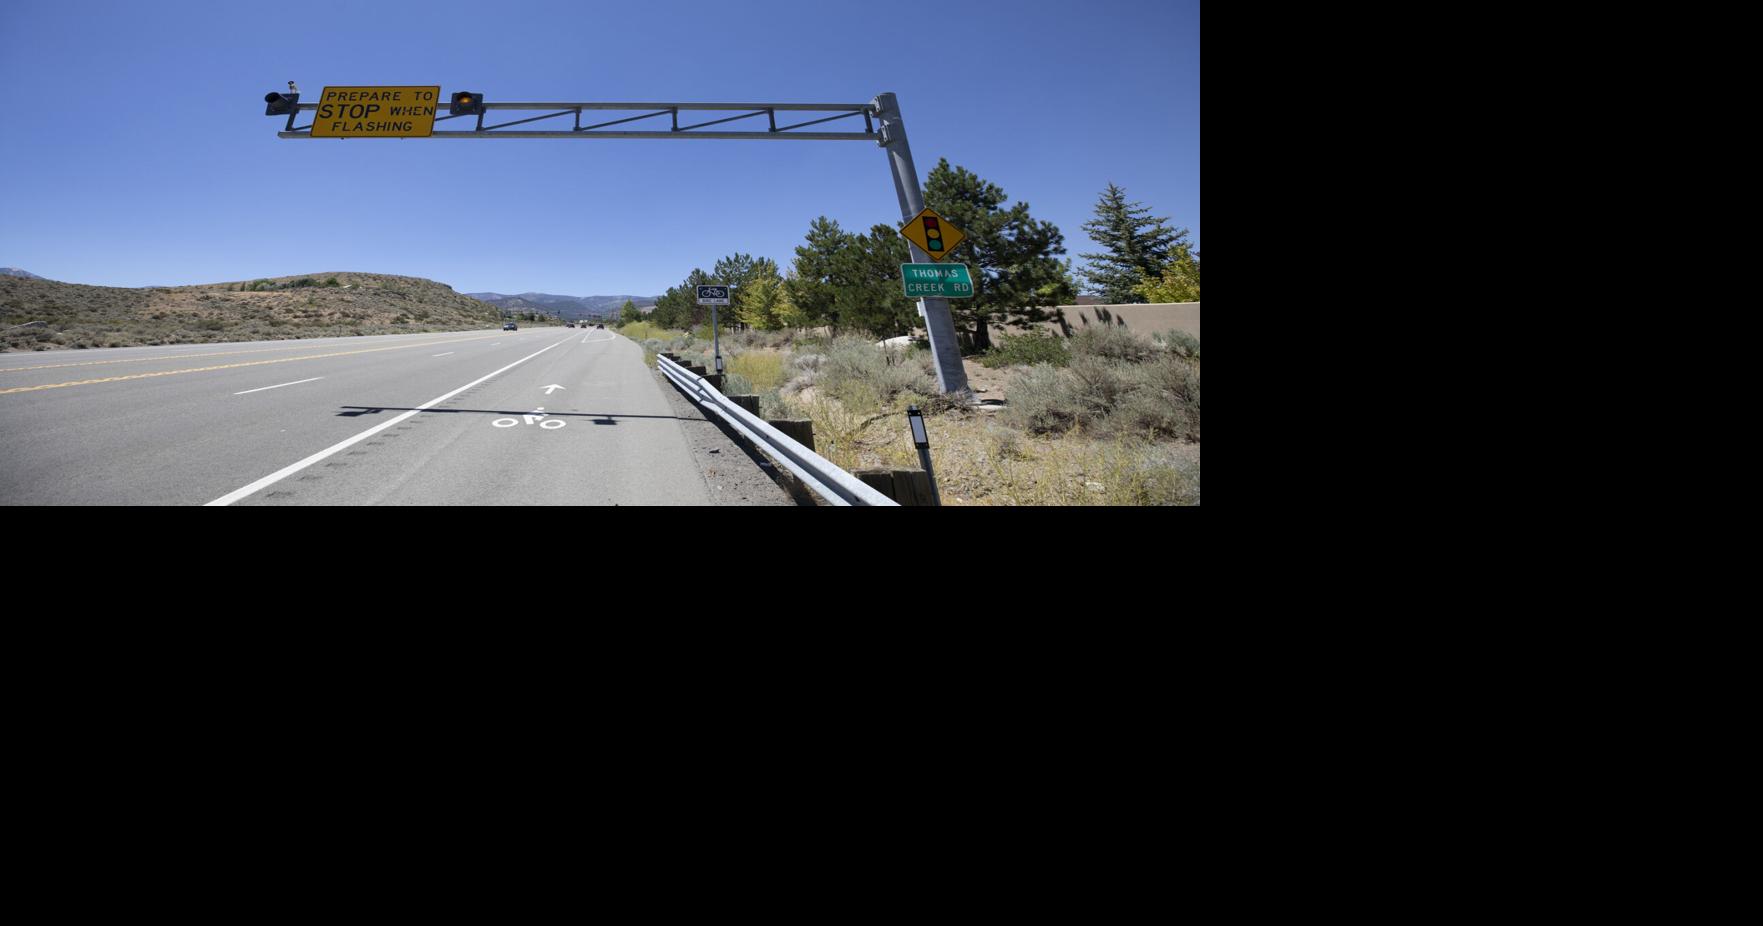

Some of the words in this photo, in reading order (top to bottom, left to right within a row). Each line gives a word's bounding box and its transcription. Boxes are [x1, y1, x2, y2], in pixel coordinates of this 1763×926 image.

[326, 91, 401, 101] PREPARE
[414, 91, 433, 101] TO
[319, 104, 380, 119] STOP
[390, 106, 434, 116] WHEN
[331, 121, 413, 132] FLASHING
[911, 269, 959, 278] THOMAS
[908, 283, 945, 292] CREEK
[953, 283, 969, 292] RD
